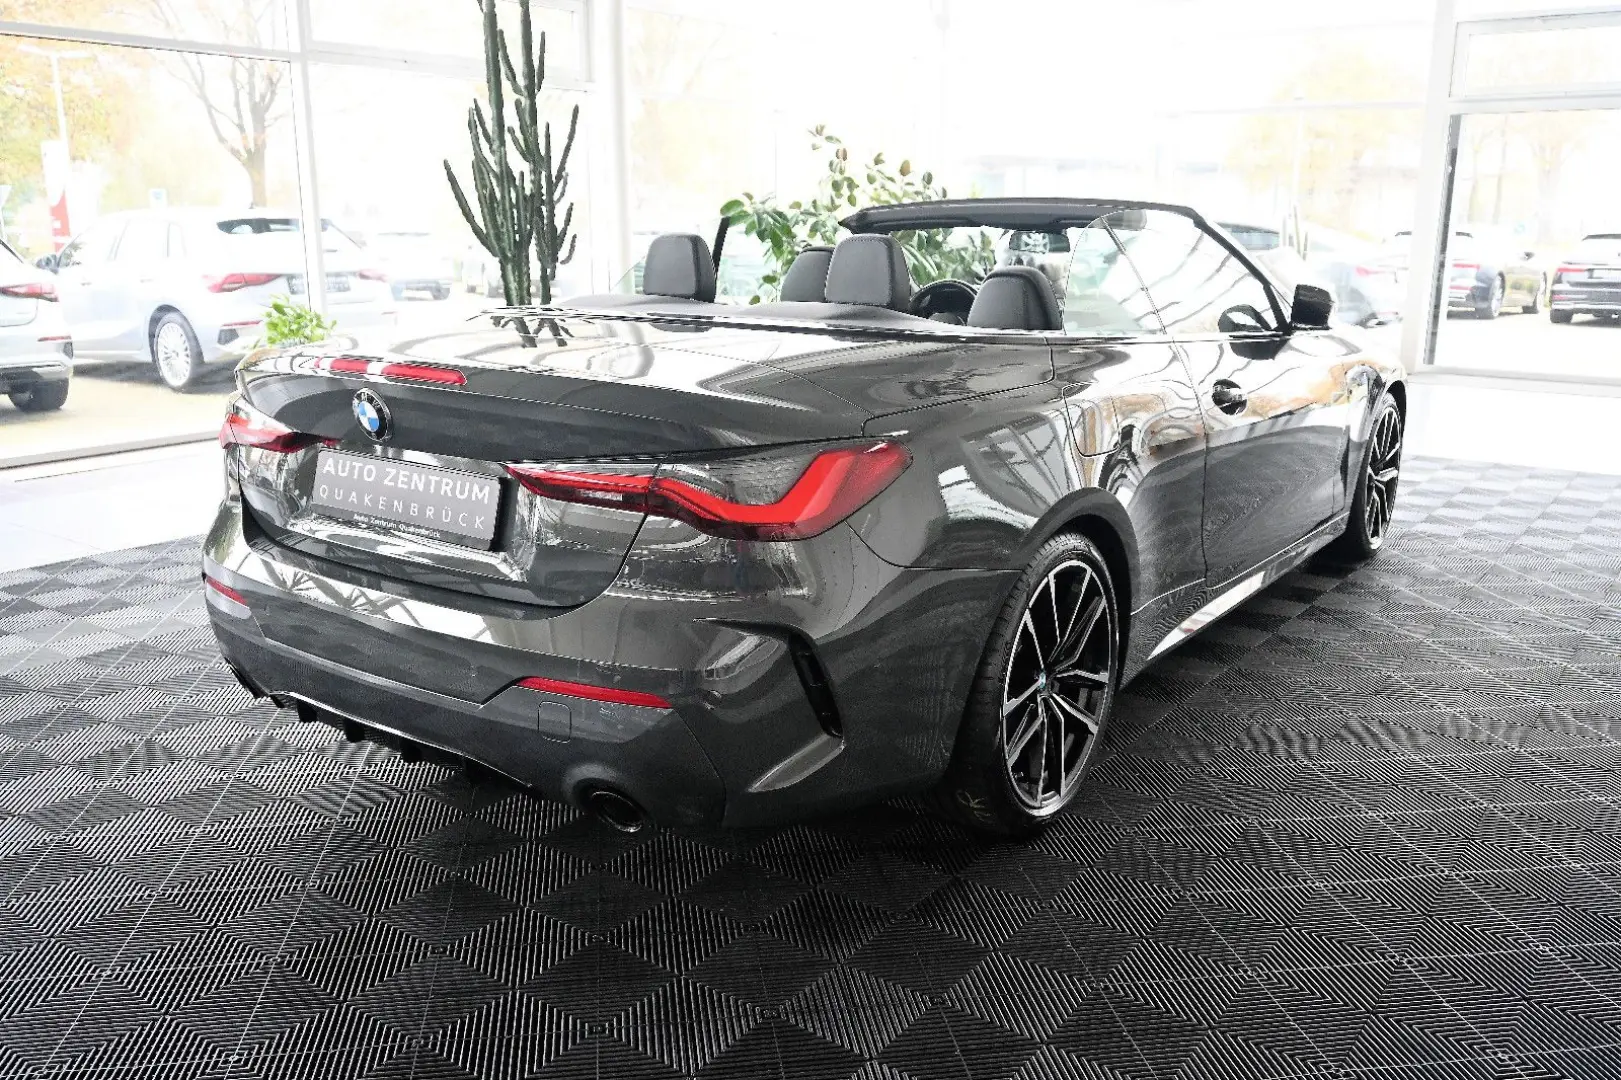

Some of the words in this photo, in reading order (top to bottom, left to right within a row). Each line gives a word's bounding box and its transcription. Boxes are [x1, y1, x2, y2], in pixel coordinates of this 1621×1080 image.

[323, 457, 376, 482] AUTO
[383, 467, 490, 504] ZENTRUM
[319, 484, 485, 530] QUAKENBRÜCK
[353, 513, 369, 523] Auto
[370, 516, 397, 529] Zentrum
[398, 523, 441, 538] Quakenbrück
